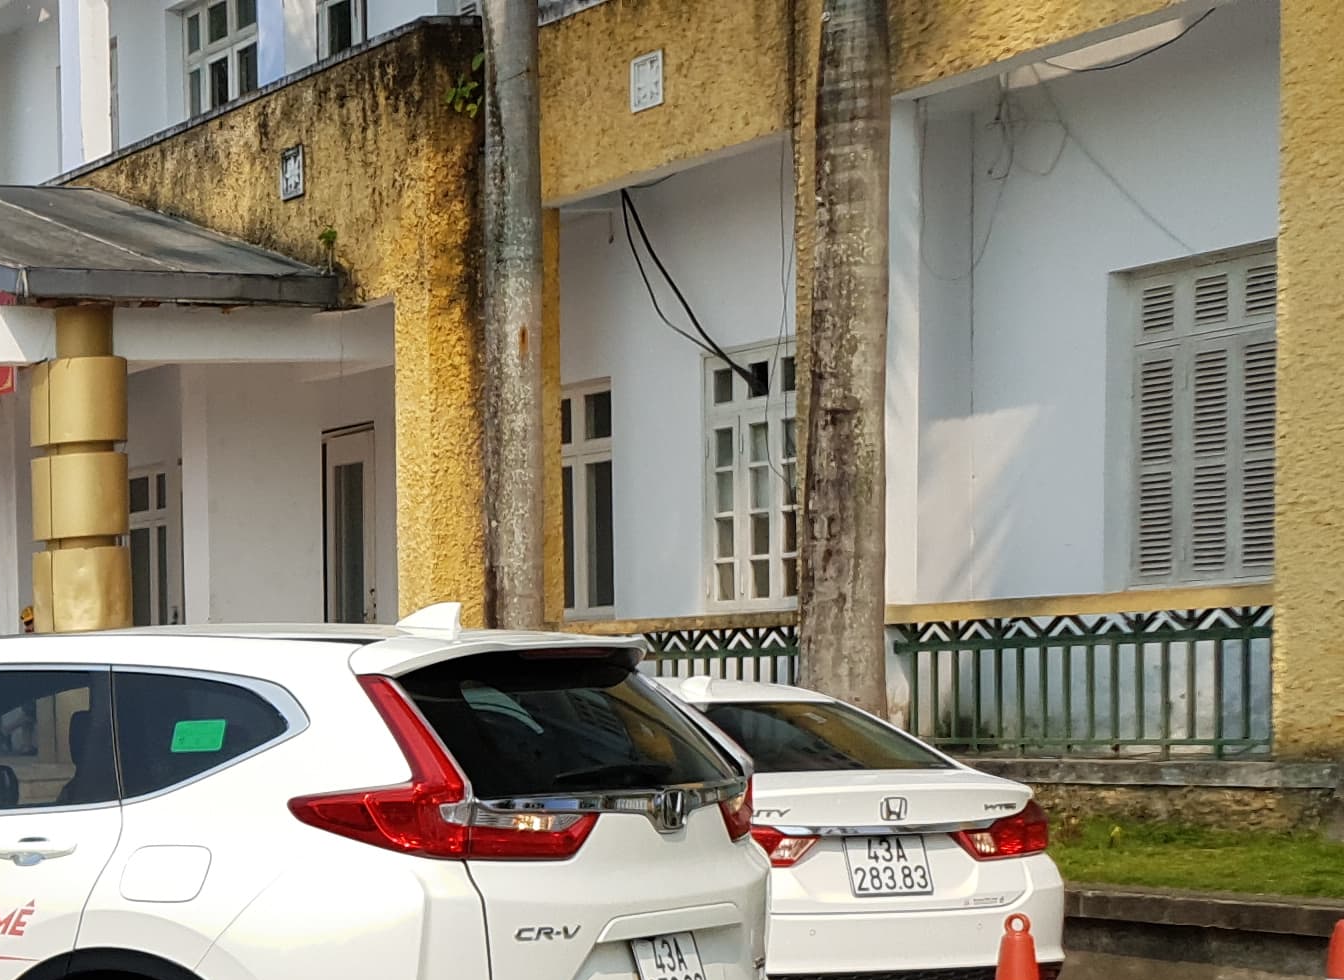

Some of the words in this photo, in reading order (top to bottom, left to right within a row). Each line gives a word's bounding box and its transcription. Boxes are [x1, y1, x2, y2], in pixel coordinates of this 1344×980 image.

[752, 808, 791, 818] ITY
[867, 837, 908, 863] 43A
[854, 865, 929, 892] 283.83
[514, 924, 581, 942] CR-V
[653, 936, 689, 973] 43A
